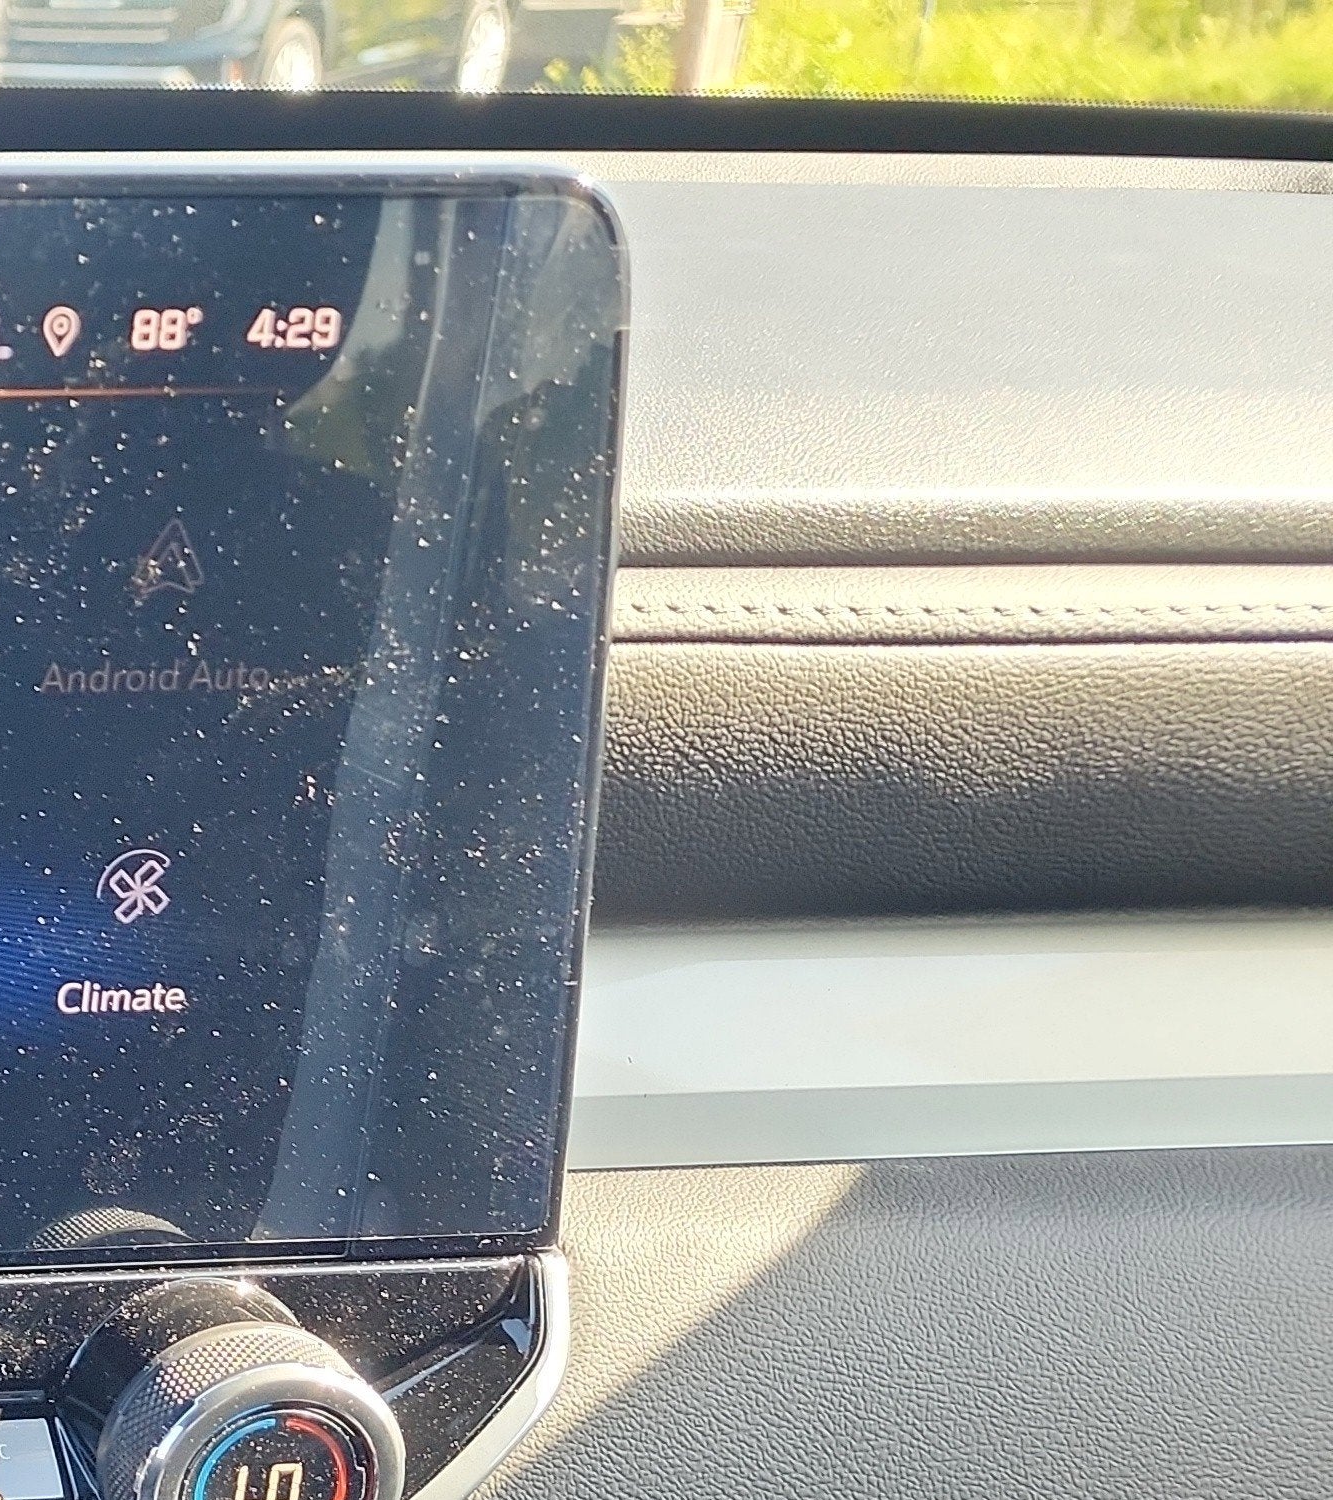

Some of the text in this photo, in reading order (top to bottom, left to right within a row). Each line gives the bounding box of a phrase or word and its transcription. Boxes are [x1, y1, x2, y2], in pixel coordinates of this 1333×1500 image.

[131, 307, 203, 351] 88°
[246, 307, 341, 349] 4:29
[42, 657, 271, 695] Android Auto
[57, 980, 187, 1016] Climate
